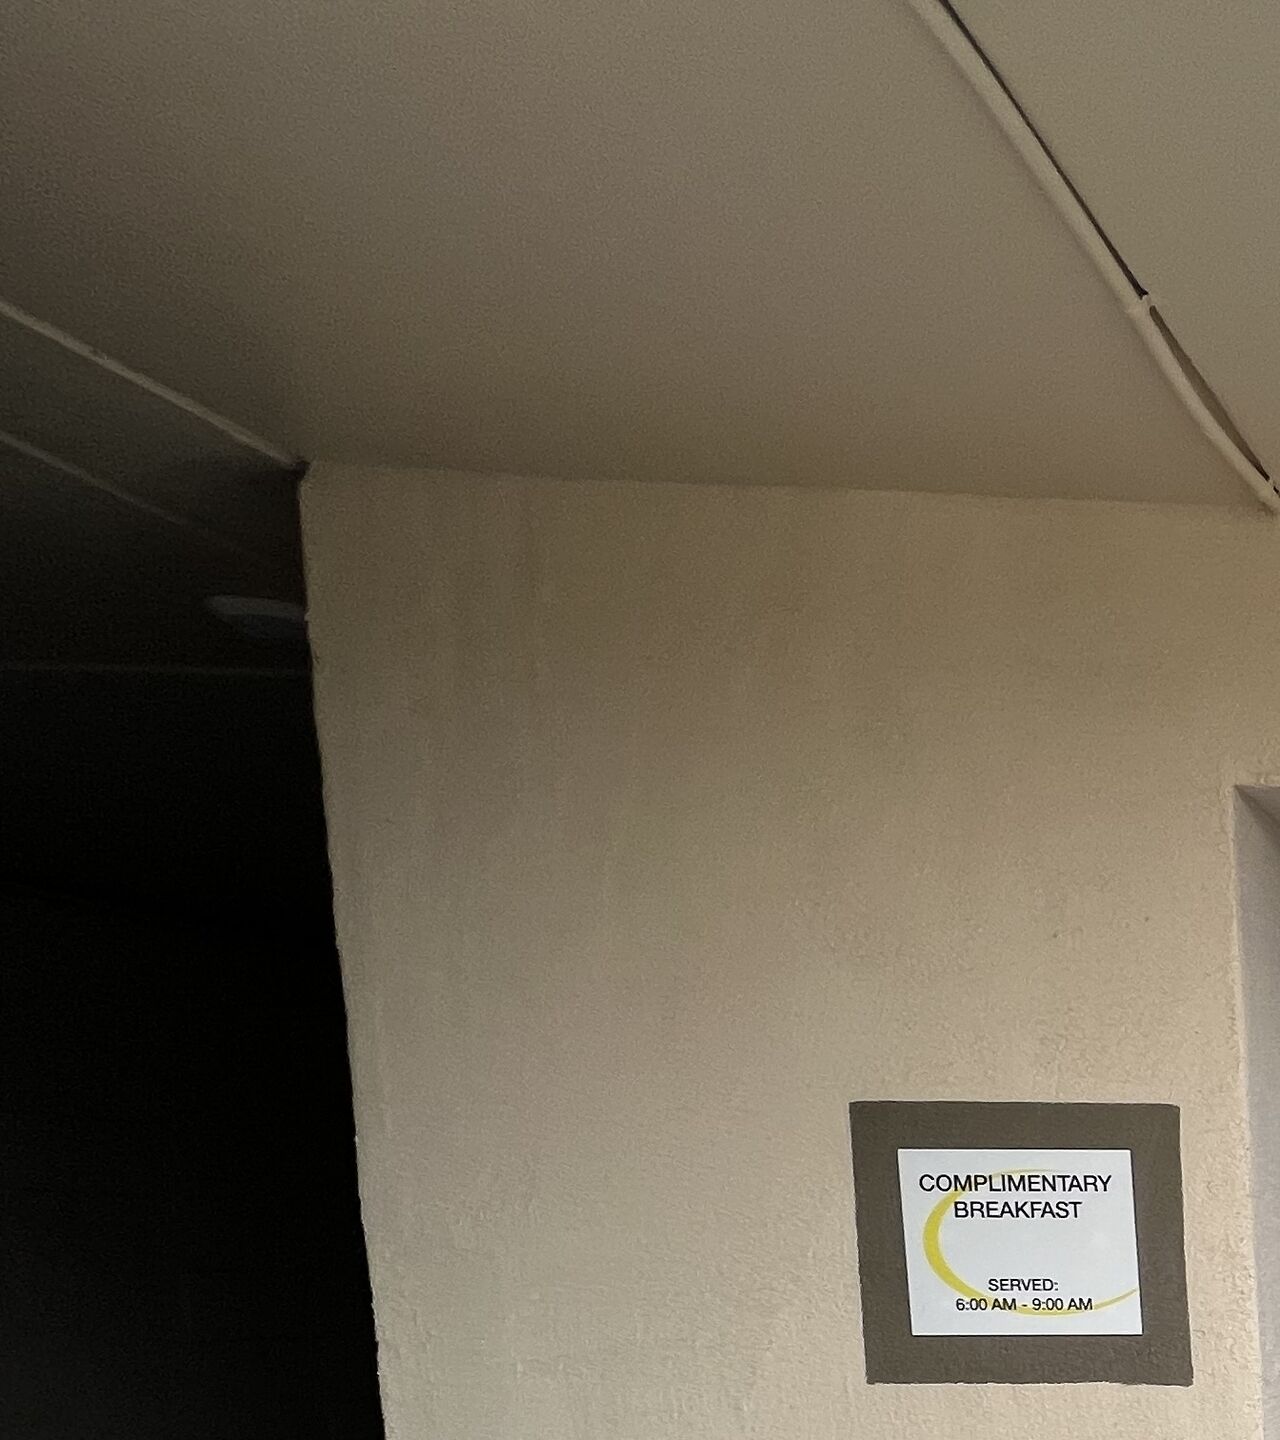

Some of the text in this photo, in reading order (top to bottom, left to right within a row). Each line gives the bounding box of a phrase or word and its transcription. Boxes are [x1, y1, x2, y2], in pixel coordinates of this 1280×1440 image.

[918, 1174, 1112, 1193] COMPLIMENTARY
[953, 1201, 1083, 1219] BREAKFAST
[987, 1278, 1059, 1292] SERVED:
[955, 1298, 988, 1312] 6:00
[991, 1298, 1018, 1311] AM
[1031, 1298, 1064, 1311] 9:00
[1067, 1298, 1093, 1311] AM
